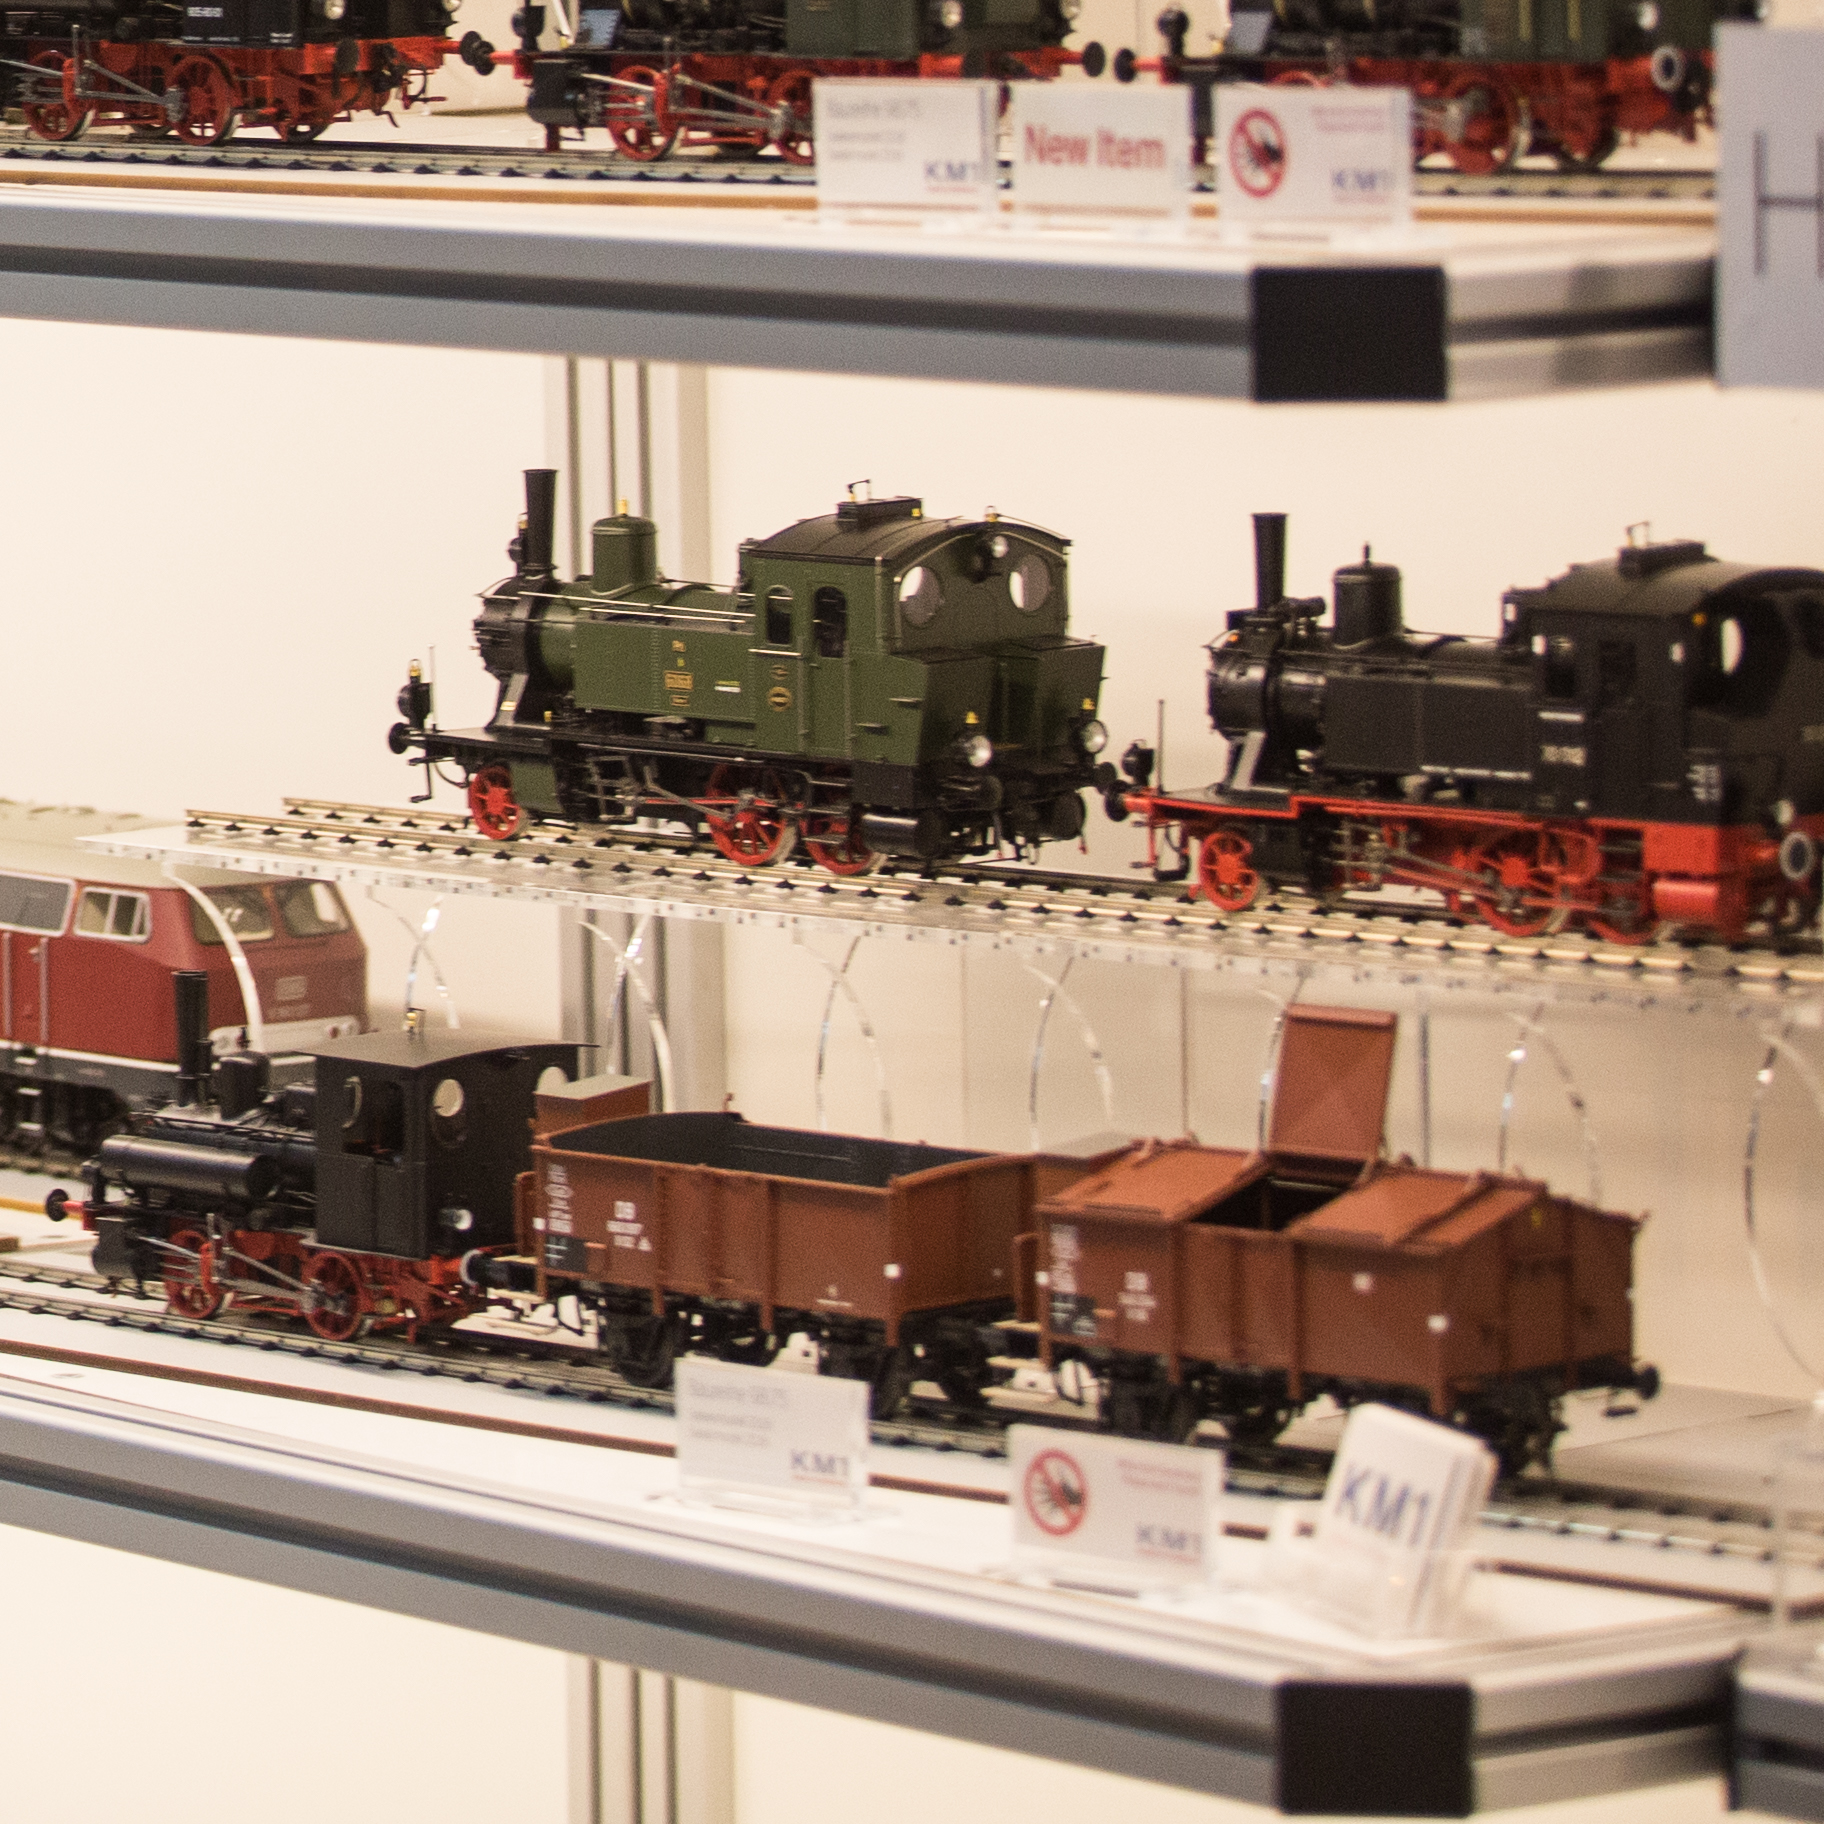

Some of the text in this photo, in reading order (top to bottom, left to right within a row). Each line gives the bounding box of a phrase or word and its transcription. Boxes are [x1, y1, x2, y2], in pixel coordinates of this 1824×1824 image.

[1024, 123, 1166, 169] New Item
[791, 1450, 849, 1476] KM1
[1334, 1463, 1430, 1549] KM1
[1136, 1523, 1202, 1555] KM1
